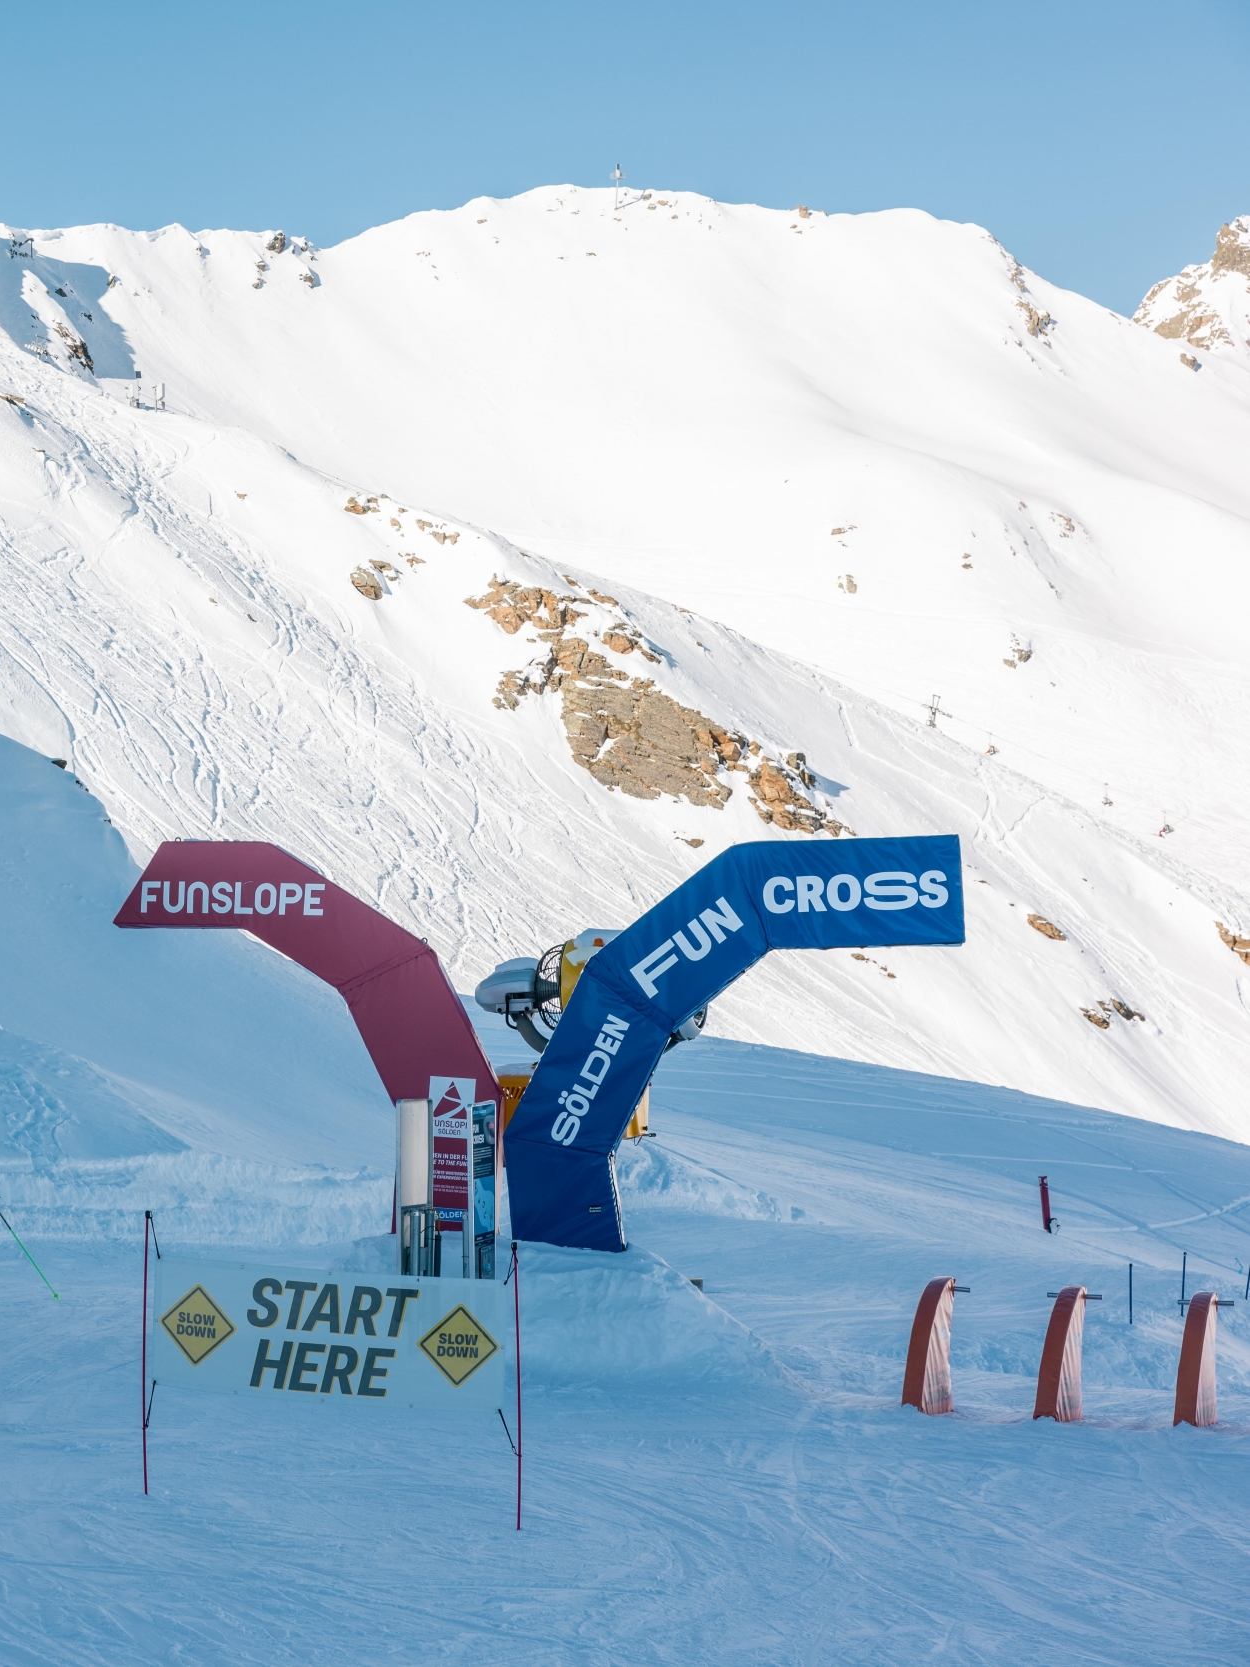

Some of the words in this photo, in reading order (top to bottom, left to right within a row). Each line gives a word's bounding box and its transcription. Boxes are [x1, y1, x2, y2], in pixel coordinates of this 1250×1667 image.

[140, 880, 326, 916] FUNSLOPE
[629, 896, 744, 999] FUN
[762, 869, 949, 914] CROSS
[551, 1013, 631, 1146] SÖLDEN
[434, 1119, 468, 1129] UNSLOP
[177, 1311, 216, 1327] SLOW
[246, 1277, 421, 1338] START
[176, 1323, 216, 1339] DOWN
[438, 1332, 479, 1346] SLOW
[436, 1344, 480, 1359] DOWN
[249, 1338, 397, 1398] HERE
